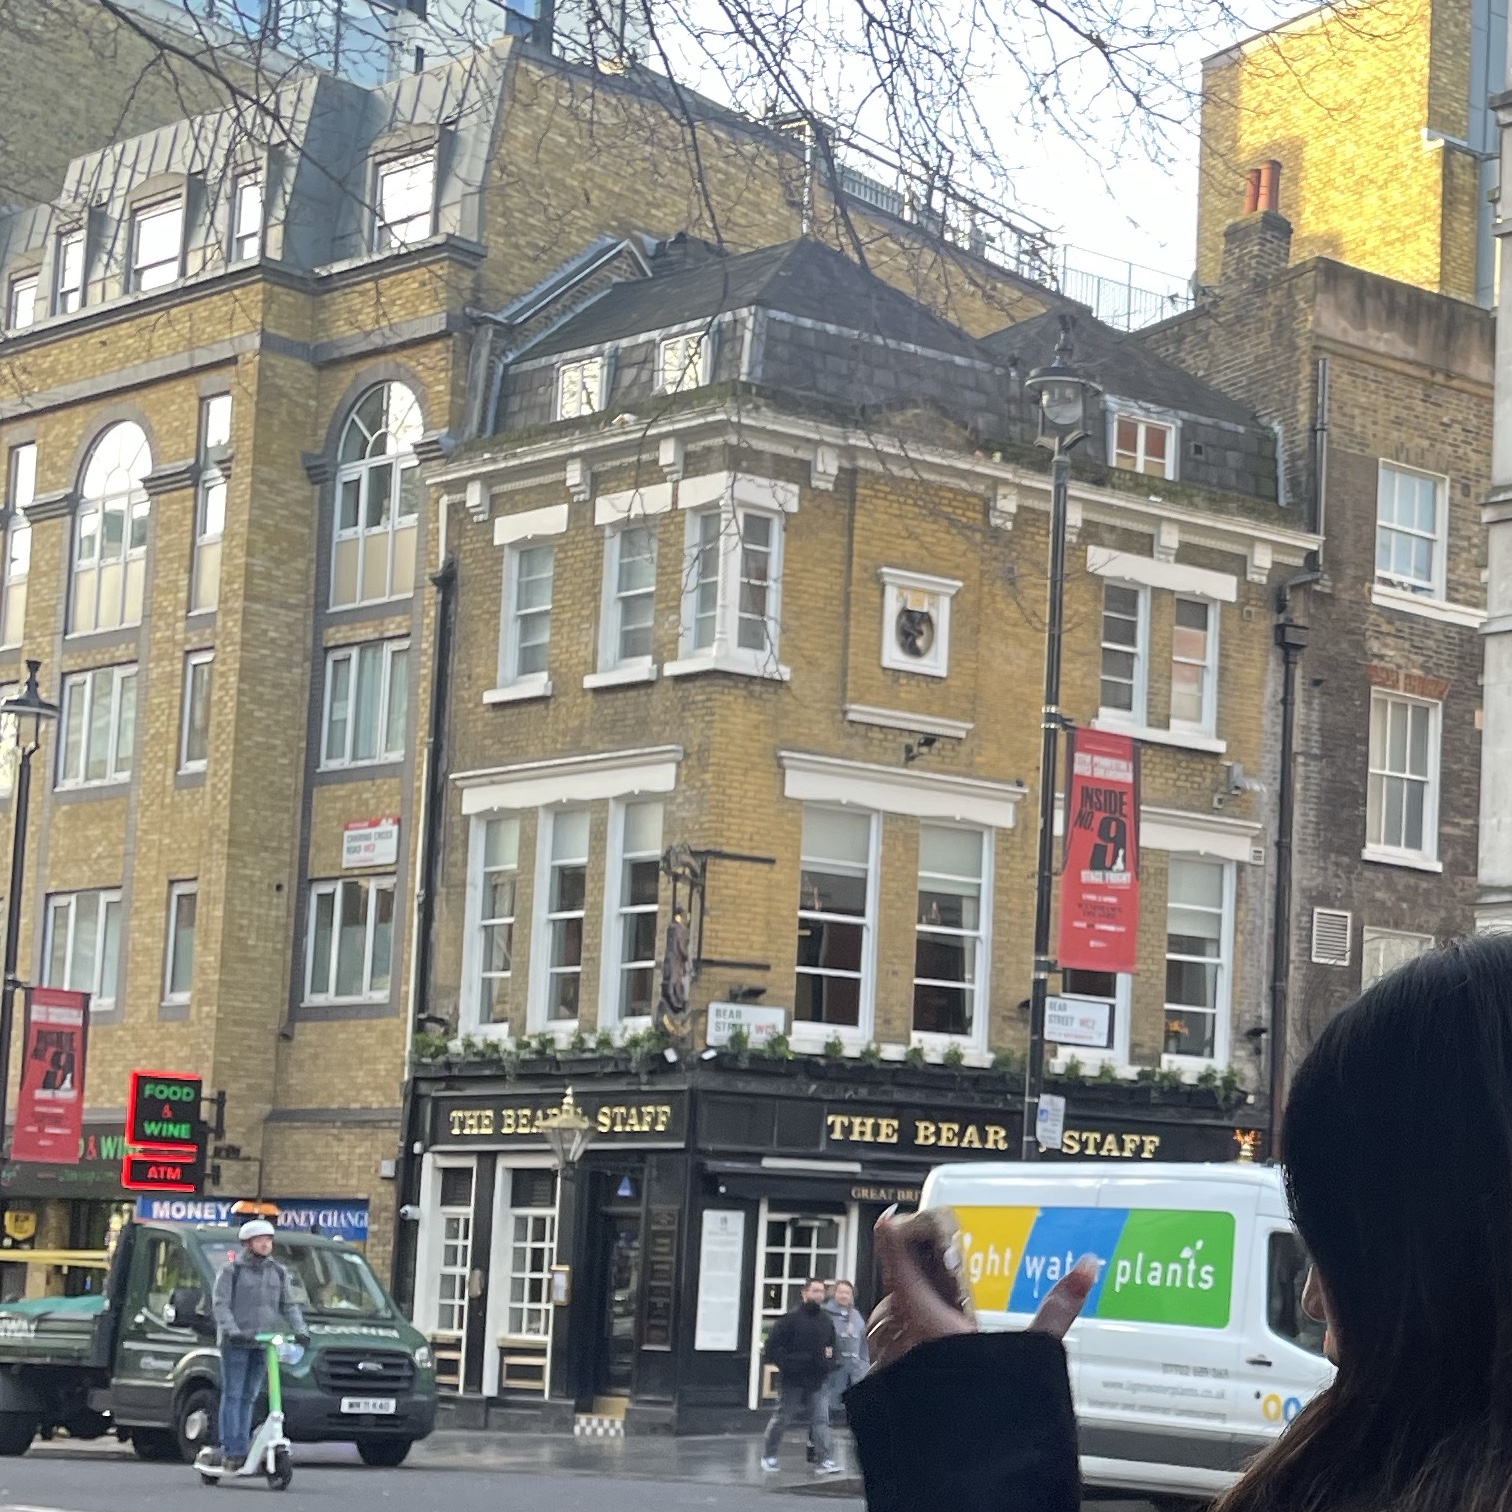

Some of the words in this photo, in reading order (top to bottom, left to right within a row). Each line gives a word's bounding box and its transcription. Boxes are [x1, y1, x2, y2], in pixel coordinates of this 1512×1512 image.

[1081, 785, 1128, 818] INSIDE
[1074, 806, 1095, 832] NO.
[1090, 816, 1127, 872] 9
[715, 1008, 742, 1020] BEAR
[144, 1083, 195, 1103] FOOD
[162, 1103, 174, 1119] &
[450, 1109, 494, 1135] THE
[597, 1106, 671, 1133] STAFF
[143, 1120, 191, 1139] WINE
[827, 1114, 899, 1144] THE
[914, 1120, 1009, 1152] BEAR
[1061, 1129, 1162, 1159] STAFF
[147, 1165, 182, 1180] ATM
[851, 1187, 894, 1201] GREAT
[152, 1200, 232, 1220] MONEY
[963, 1233, 1012, 1284] ight
[1025, 1250, 1107, 1299] watr
[1114, 1240, 1215, 1293] plants
